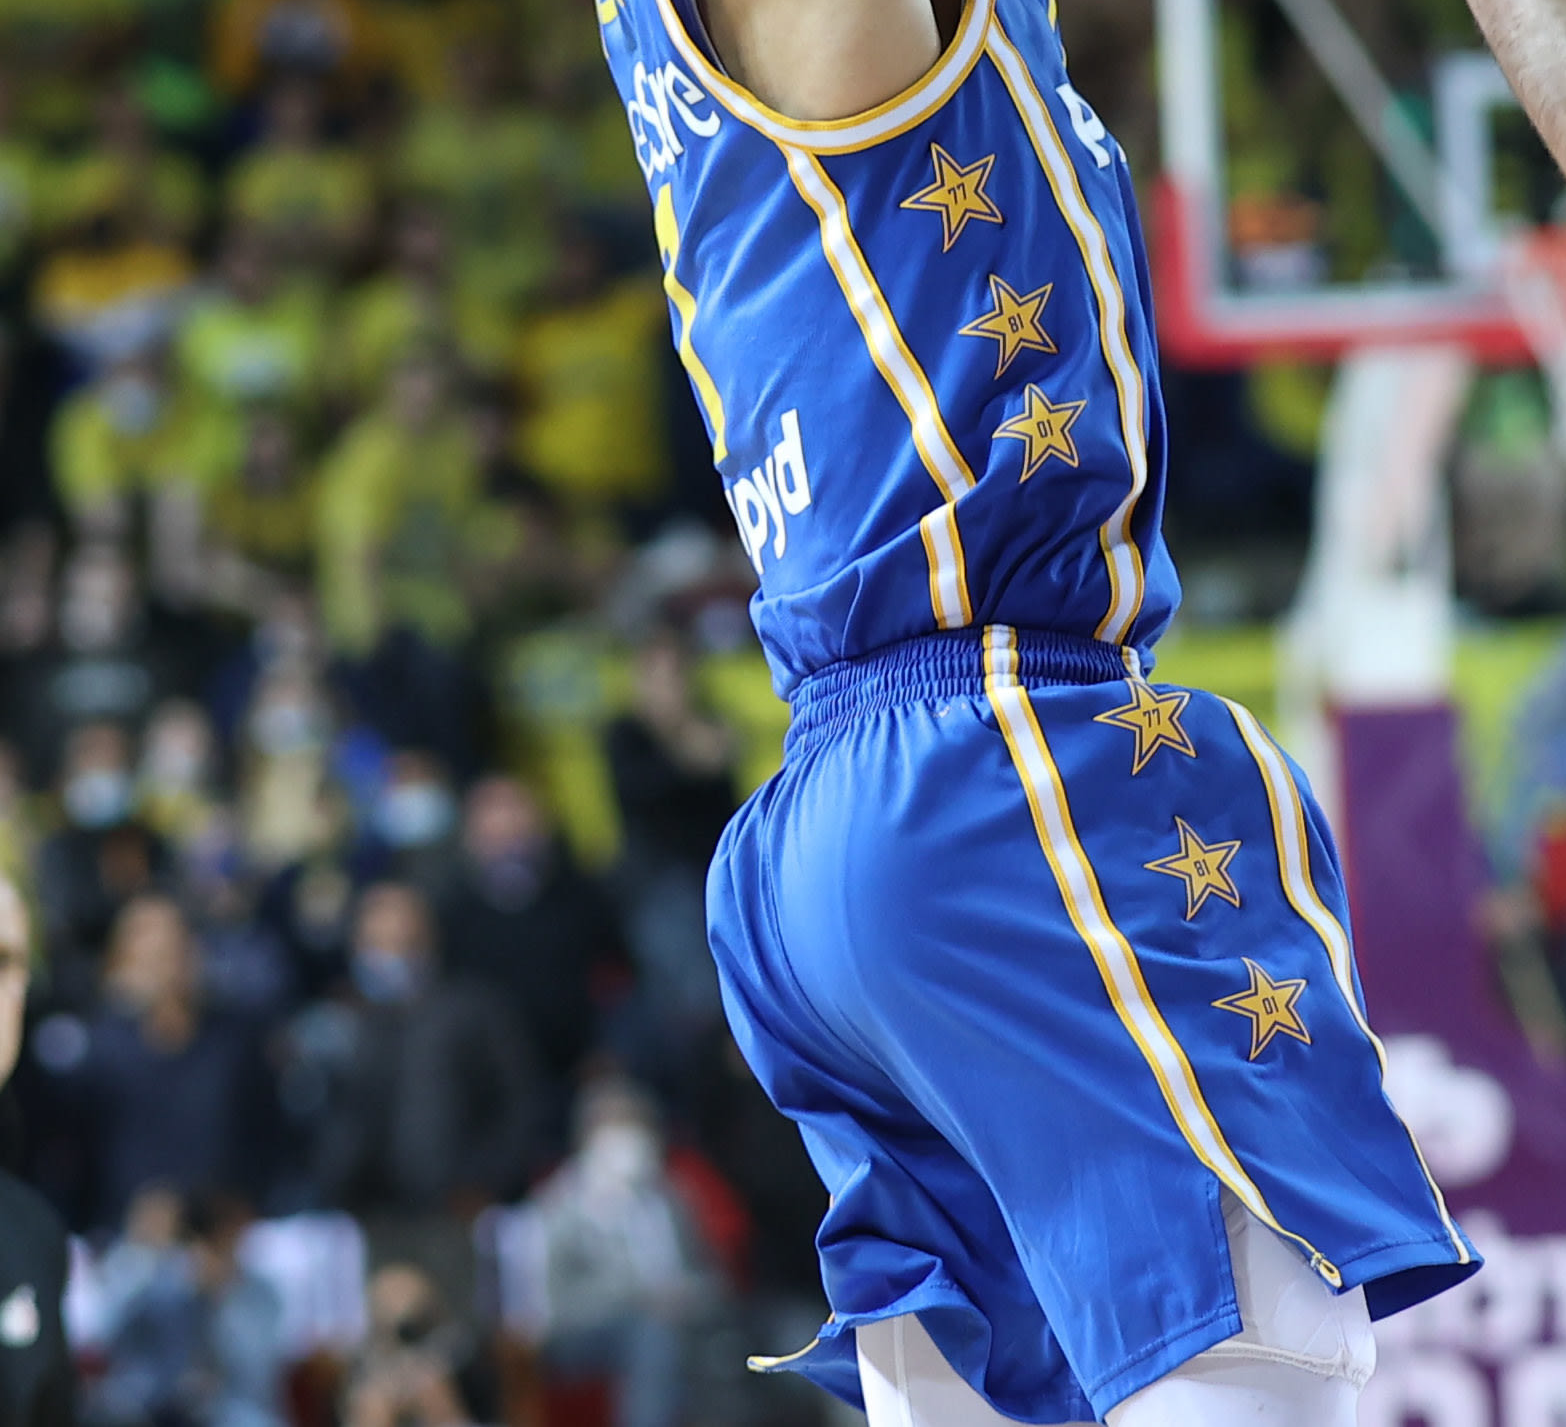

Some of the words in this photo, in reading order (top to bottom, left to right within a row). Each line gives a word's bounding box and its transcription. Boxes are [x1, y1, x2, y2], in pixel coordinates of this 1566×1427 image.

[948, 182, 967, 205] 77
[1008, 313, 1025, 334] 81
[724, 408, 812, 575] pyd
[1142, 708, 1161, 728] 77
[1193, 858, 1211, 877] 81
